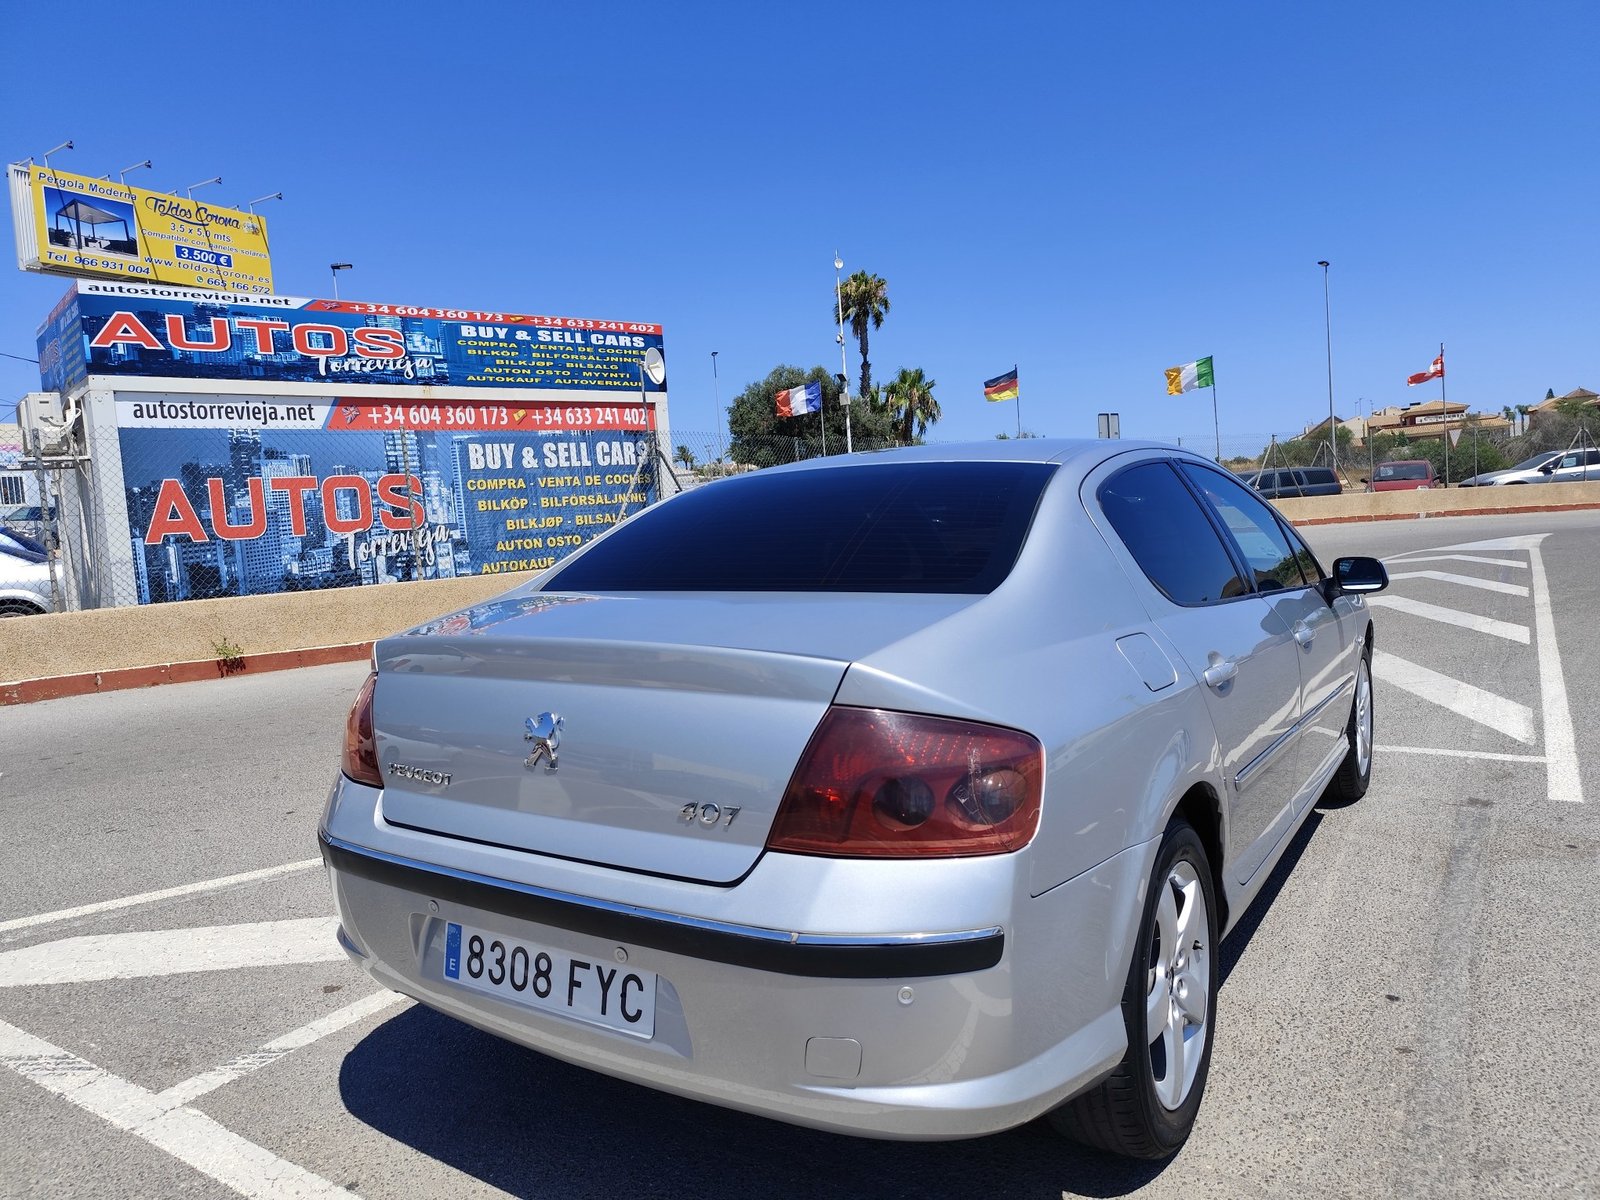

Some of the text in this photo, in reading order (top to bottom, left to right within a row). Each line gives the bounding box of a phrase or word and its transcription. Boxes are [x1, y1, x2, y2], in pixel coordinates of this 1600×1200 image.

[88, 182, 137, 201] Moderna
[145, 196, 192, 220] Toldos
[195, 206, 240, 230] Corona
[141, 228, 268, 259] Compatible con paneles solares
[170, 222, 185, 233] 3.5
[188, 226, 194, 235] x
[213, 232, 234, 243] mts.
[47, 251, 151, 275] Tel. 966 931 004
[181, 247, 229, 266] 3.500 €
[144, 256, 270, 284] www.toldoscorona.es
[88, 283, 292, 306] autostorrevieja.net
[207, 278, 270, 295] 665 166 572
[349, 304, 655, 333] +34 604 360 173 +34 633 241 402
[90, 310, 407, 360] AUTOS
[460, 325, 645, 348] BUY & SELL CARS
[457, 340, 518, 349] COMPRA
[530, 344, 573, 352] VENTA
[597, 348, 647, 356] COCHES
[467, 349, 519, 357] BILKÖP
[316, 352, 433, 380] Torrevieja
[483, 367, 531, 375] AUTON
[582, 371, 631, 379] MYYNTI
[565, 362, 619, 370] BILSALG
[466, 375, 543, 384] AUTOKAUF
[133, 400, 315, 425] autostorrevieja.net
[367, 404, 647, 426] +34 604 360 173 +34 633 241 402
[468, 443, 515, 470] BUY
[521, 447, 538, 468] &
[543, 442, 591, 468] SELL
[467, 478, 526, 491] COMPRA
[538, 475, 581, 489] VENTA
[585, 476, 601, 486] DE
[145, 474, 426, 545] AUTOS
[478, 497, 529, 512] BILKÖP
[506, 516, 563, 531] BILKJØP
[496, 534, 543, 552] AUTON
[547, 534, 581, 547] OSTO
[482, 557, 555, 574] AUTOKAUF
[388, 761, 453, 786] PEUGEOT
[679, 801, 742, 827] 407
[449, 934, 644, 1023] E 8308 FYC
